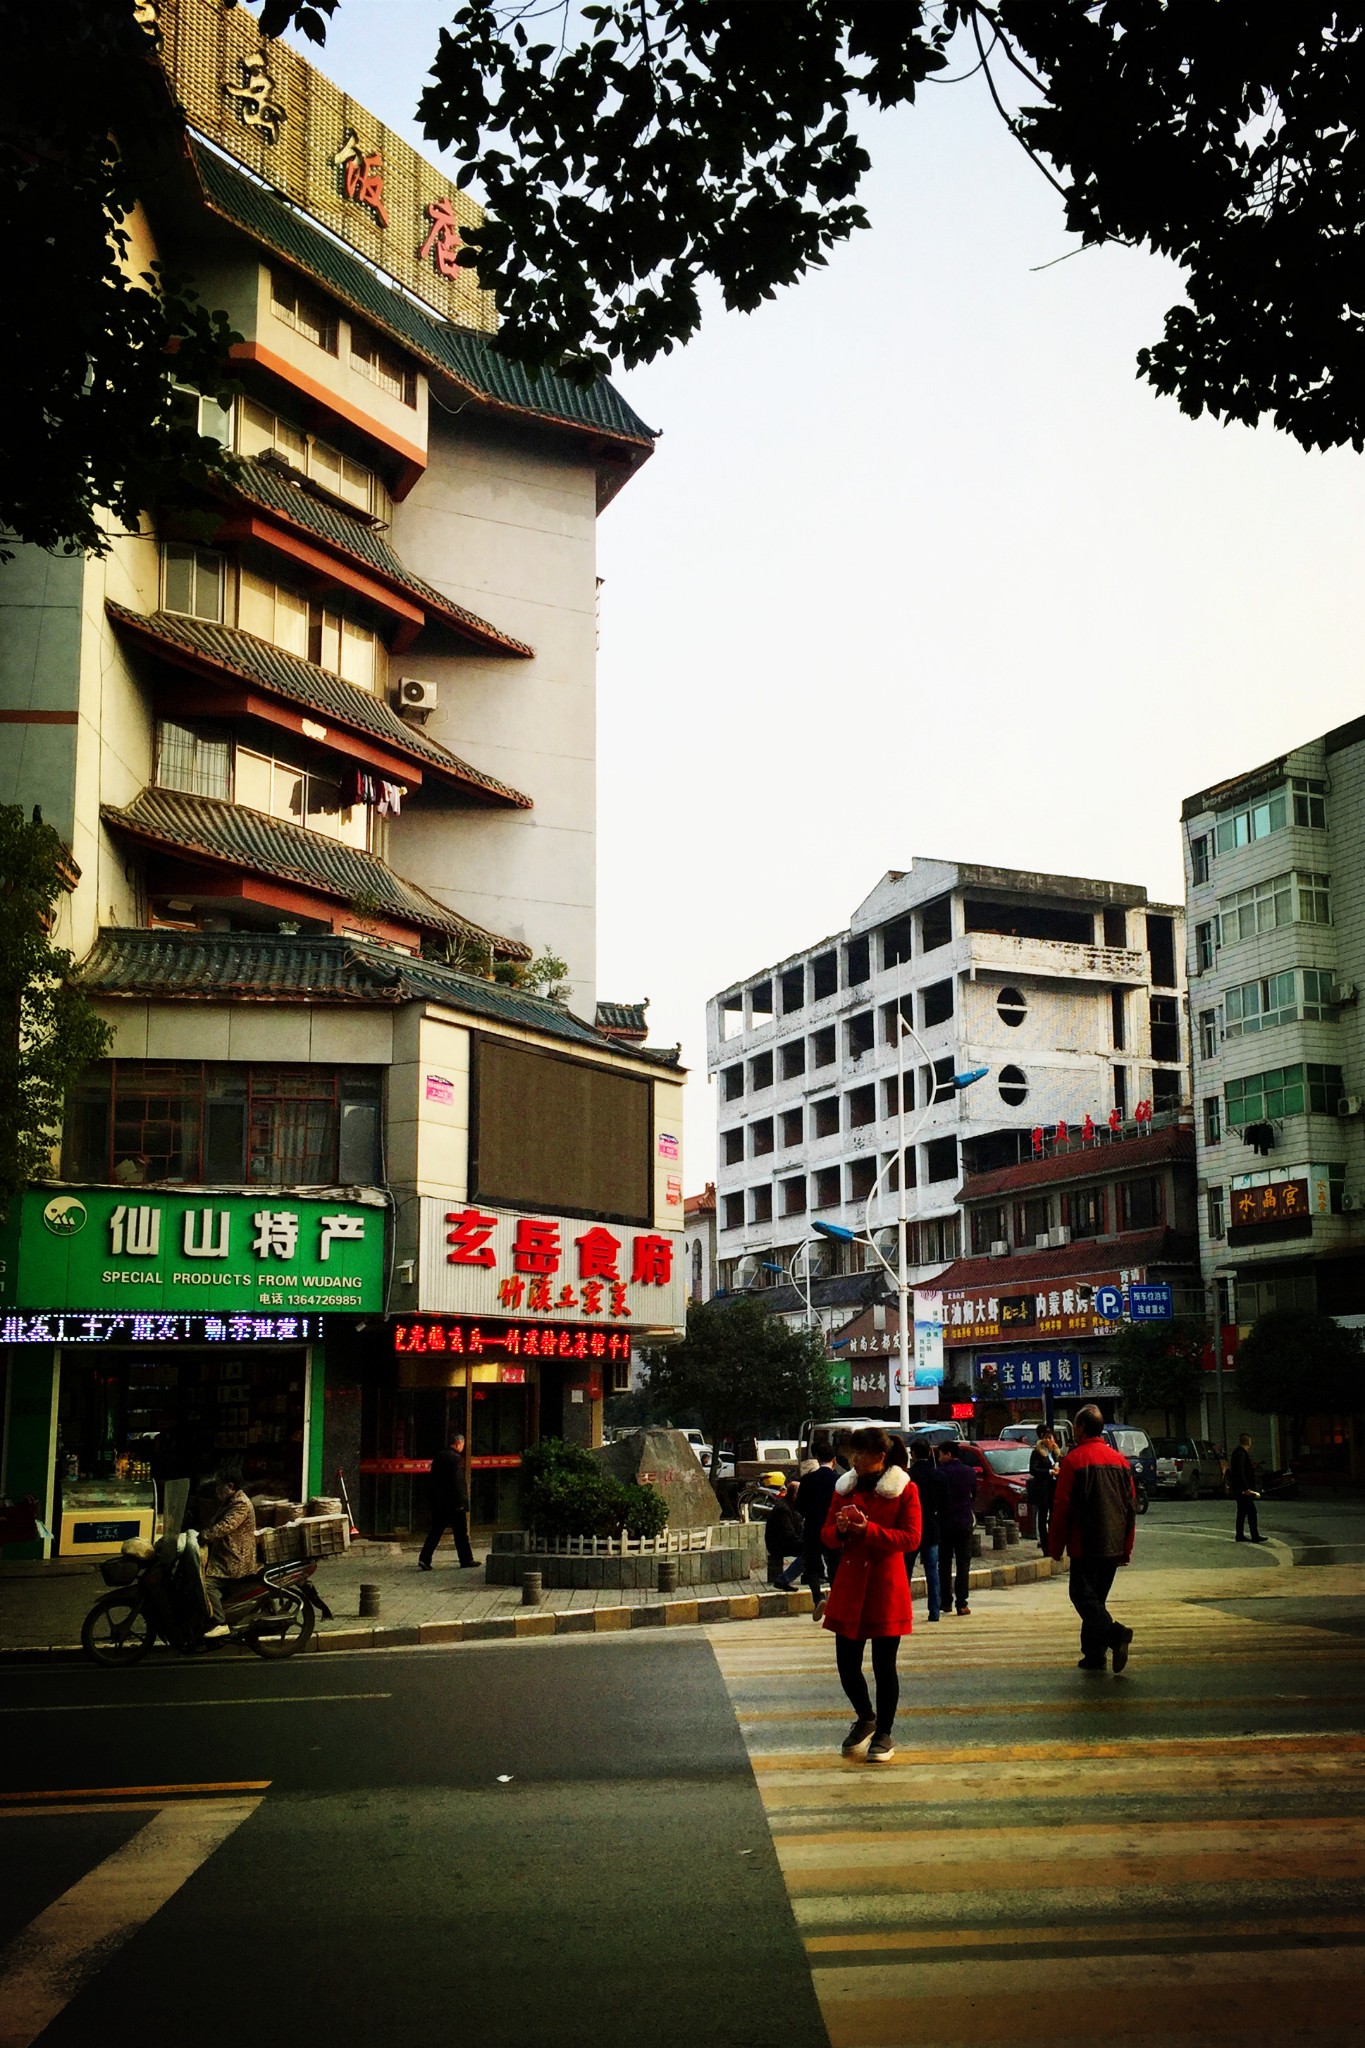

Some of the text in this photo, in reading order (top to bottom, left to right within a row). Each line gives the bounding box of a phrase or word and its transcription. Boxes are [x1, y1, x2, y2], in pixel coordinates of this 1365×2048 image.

[1238, 1184, 1299, 1212] 水晶宫
[1315, 1180, 1327, 1212] 水晶宫
[109, 1204, 366, 1261] 仙山特产
[445, 1208, 674, 1286] 玄岳食府
[101, 1270, 363, 1288] SPECIAL PRODUCTS FROM WUDANG
[258, 1293, 363, 1306] 电话 13647269851
[496, 1273, 632, 1318] 竹溪土家菜
[1102, 1292, 1117, 1314] P
[1133, 1291, 1169, 1302] 按车位泊车
[849, 1330, 912, 1353] 时尚之都发
[1001, 1358, 1073, 1385] 宝岛眼镜
